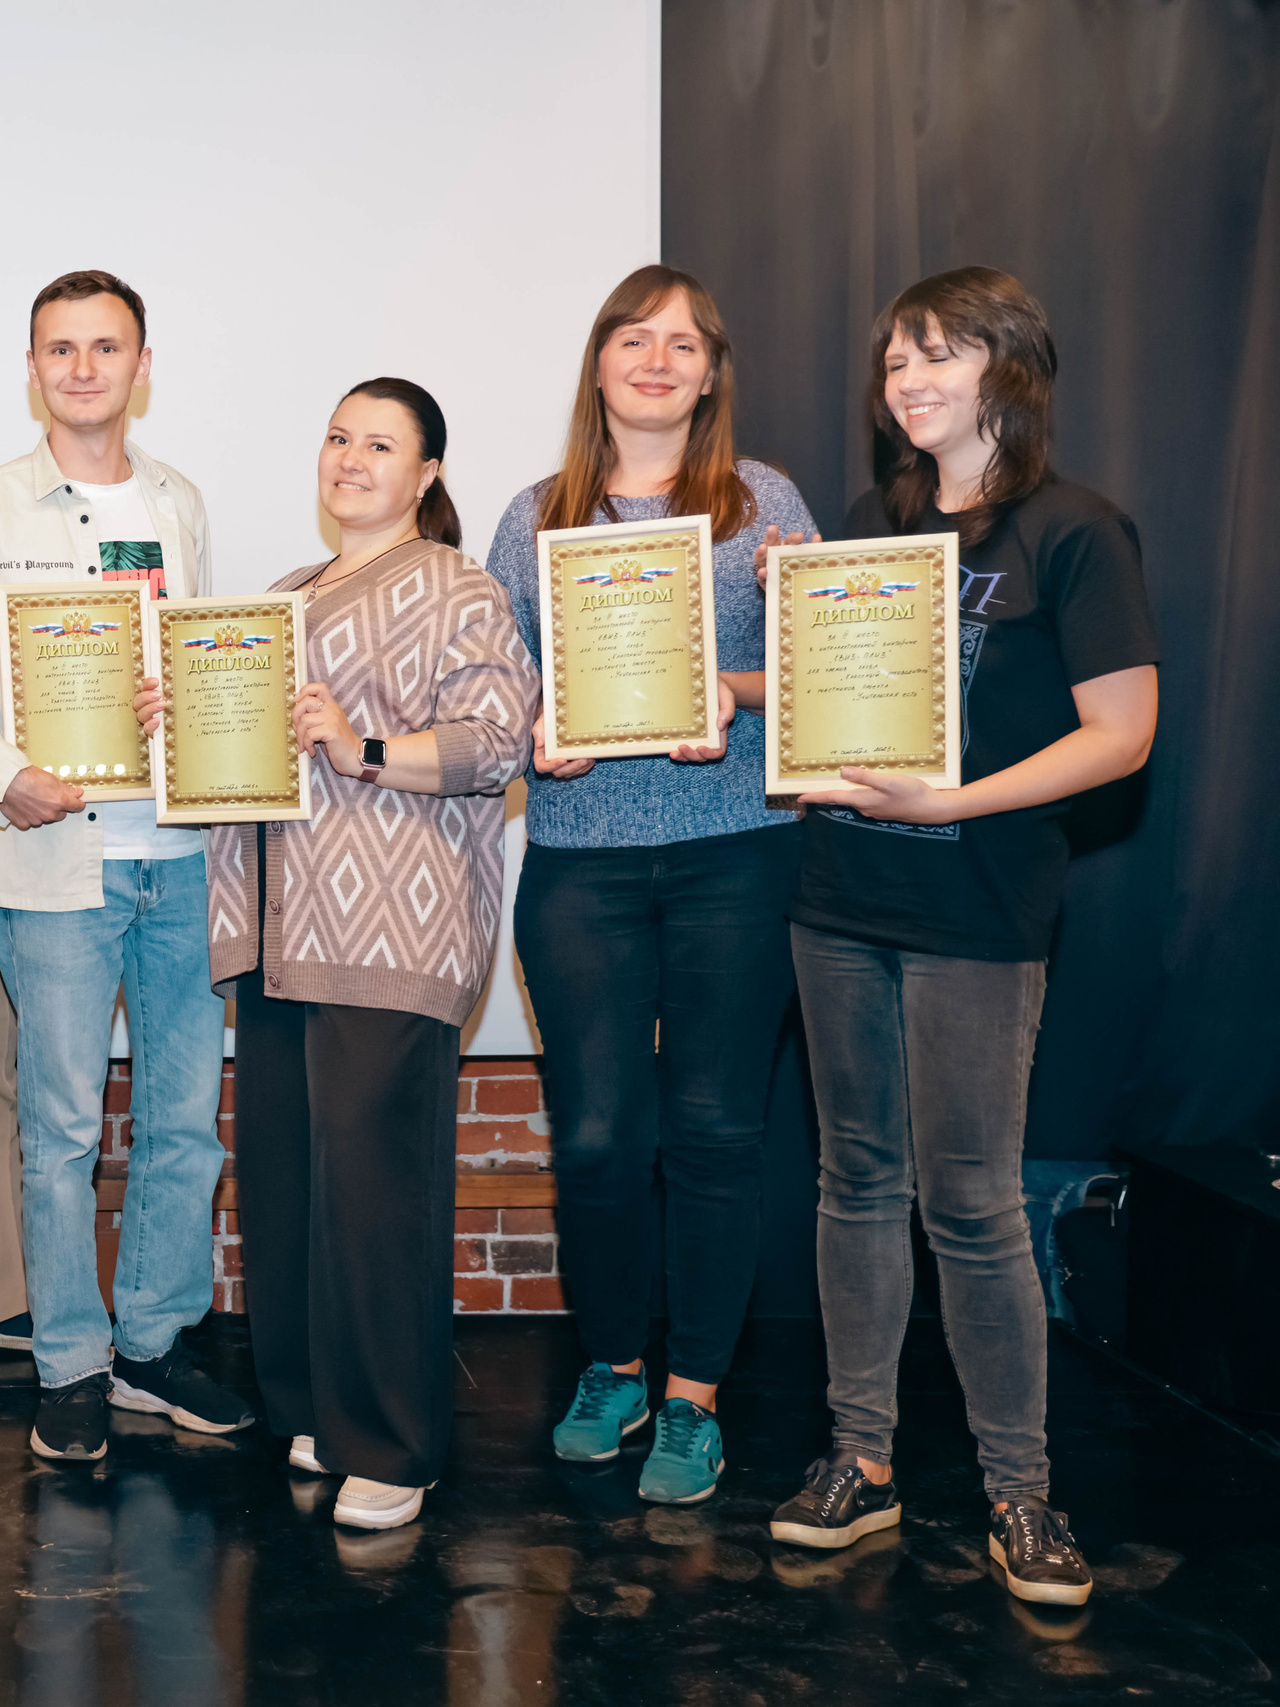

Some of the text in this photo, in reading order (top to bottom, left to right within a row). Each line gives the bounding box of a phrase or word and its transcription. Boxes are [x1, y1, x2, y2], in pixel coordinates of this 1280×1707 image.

[25, 560, 74, 570] Playground
[579, 587, 673, 613] ДИПЛОМ
[810, 603, 915, 628] ДИПЛОМ
[36, 641, 119, 660] ДИПЛОМ
[187, 655, 271, 675] ДИПЛОМ
